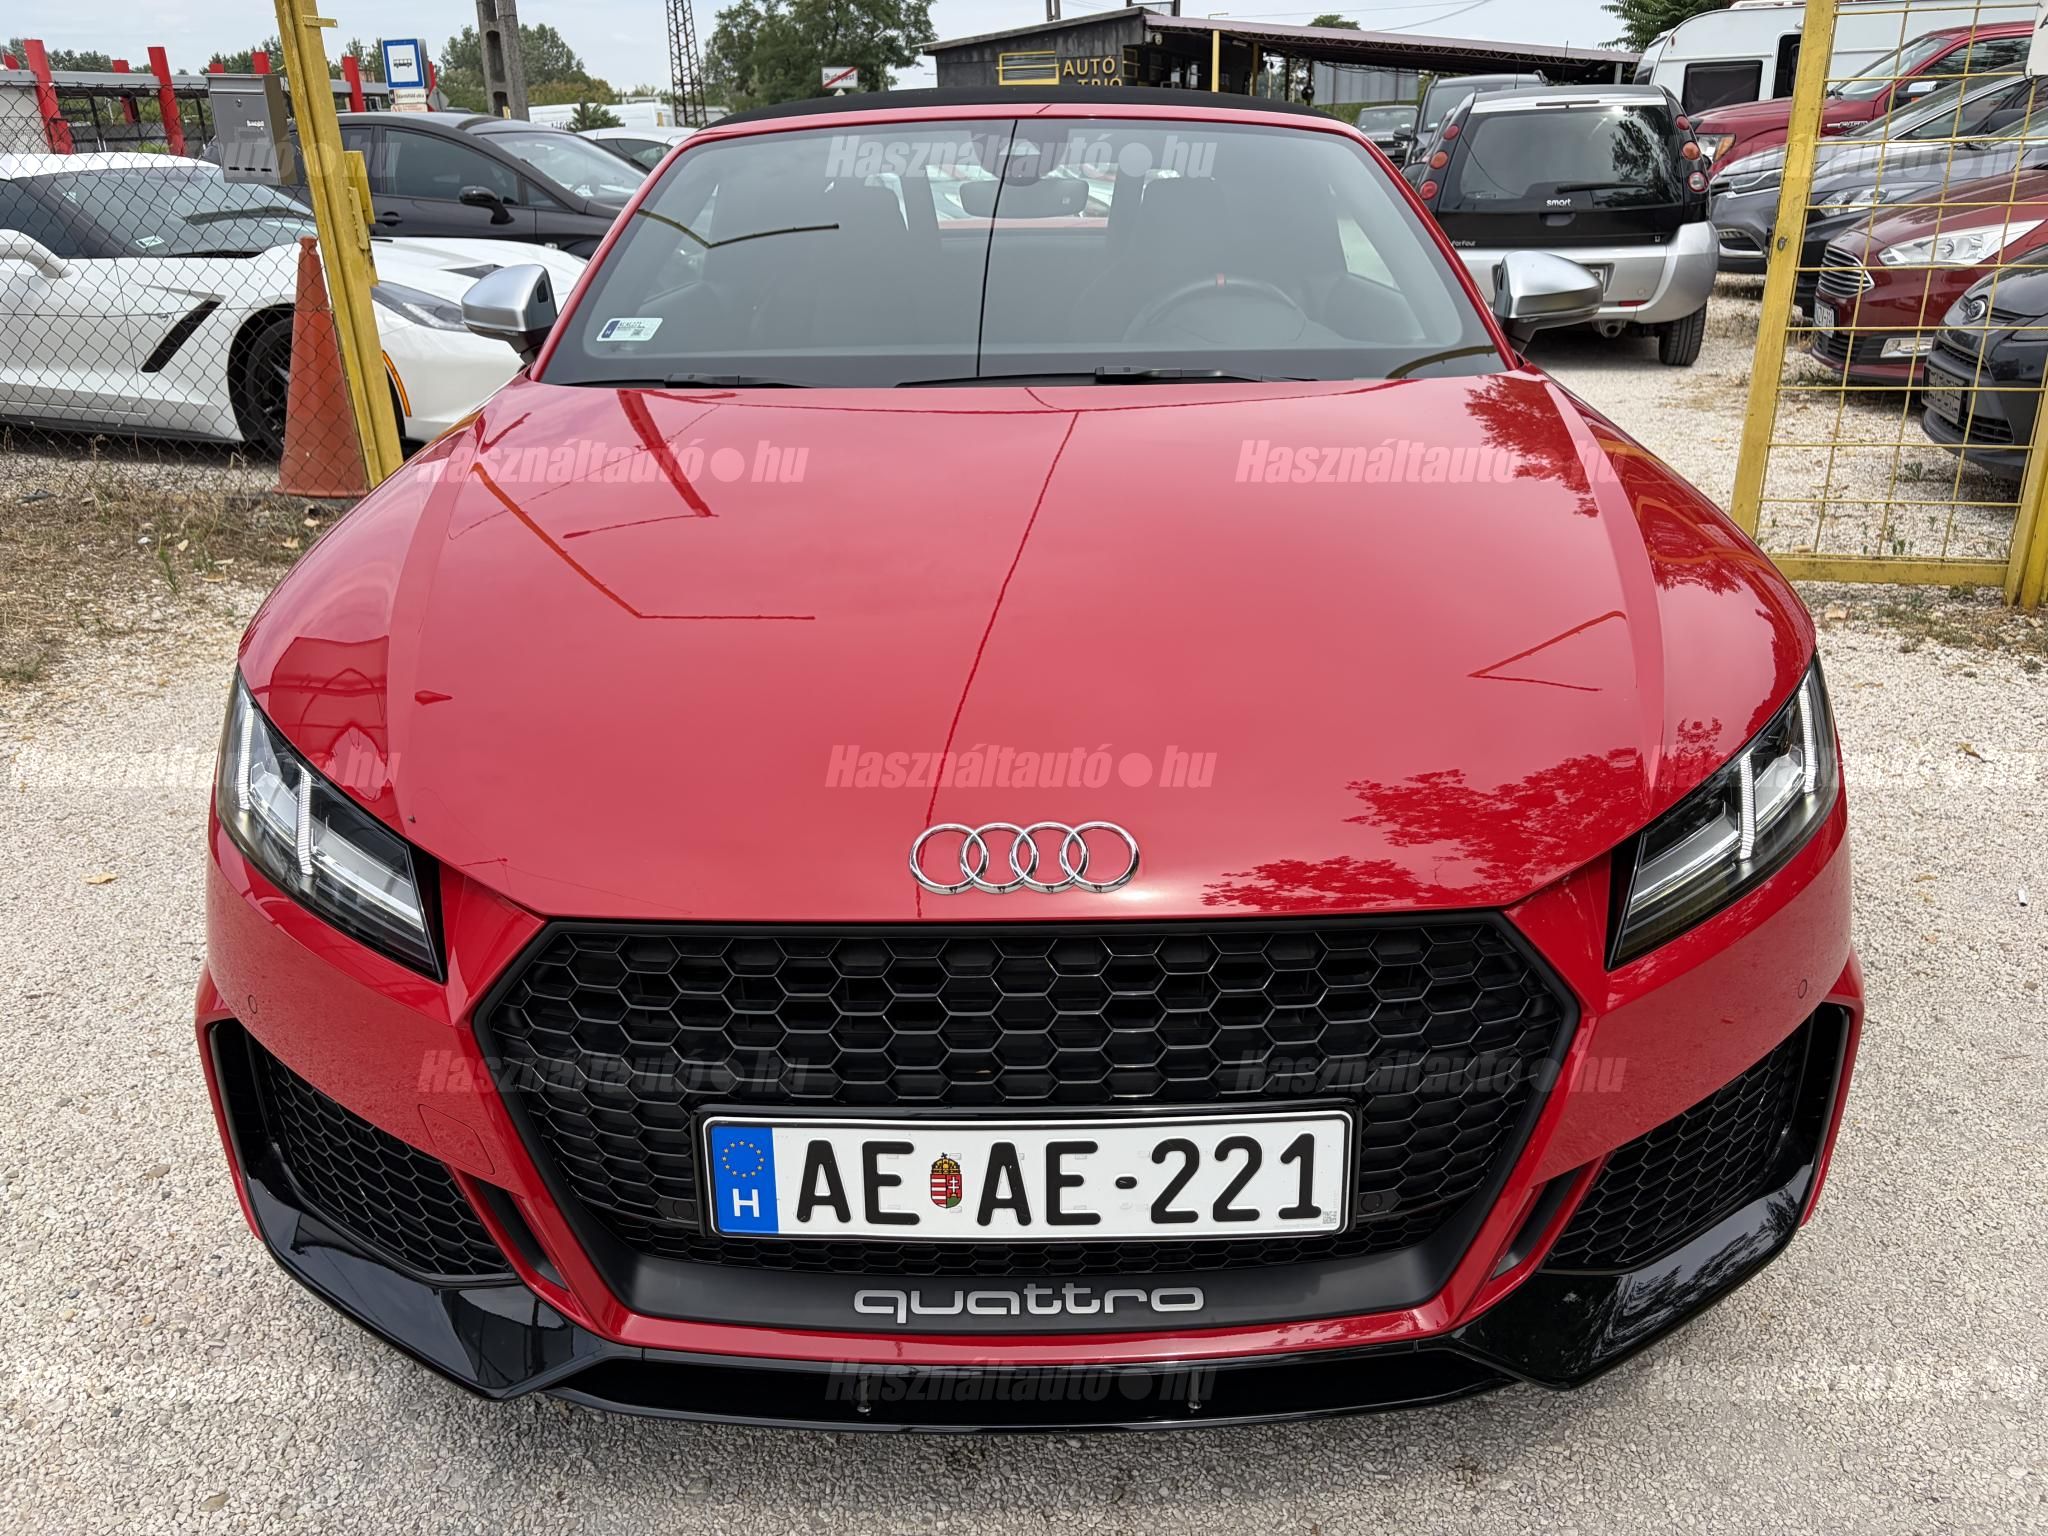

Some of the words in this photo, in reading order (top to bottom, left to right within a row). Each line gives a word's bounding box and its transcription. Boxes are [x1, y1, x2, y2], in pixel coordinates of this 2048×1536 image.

[1063, 55, 1115, 76] AUTÓ
[1546, 198, 1571, 207] smart
[797, 1139, 920, 1225] AE
[732, 1188, 760, 1218] H
[854, 1283, 1205, 1324] quattro
